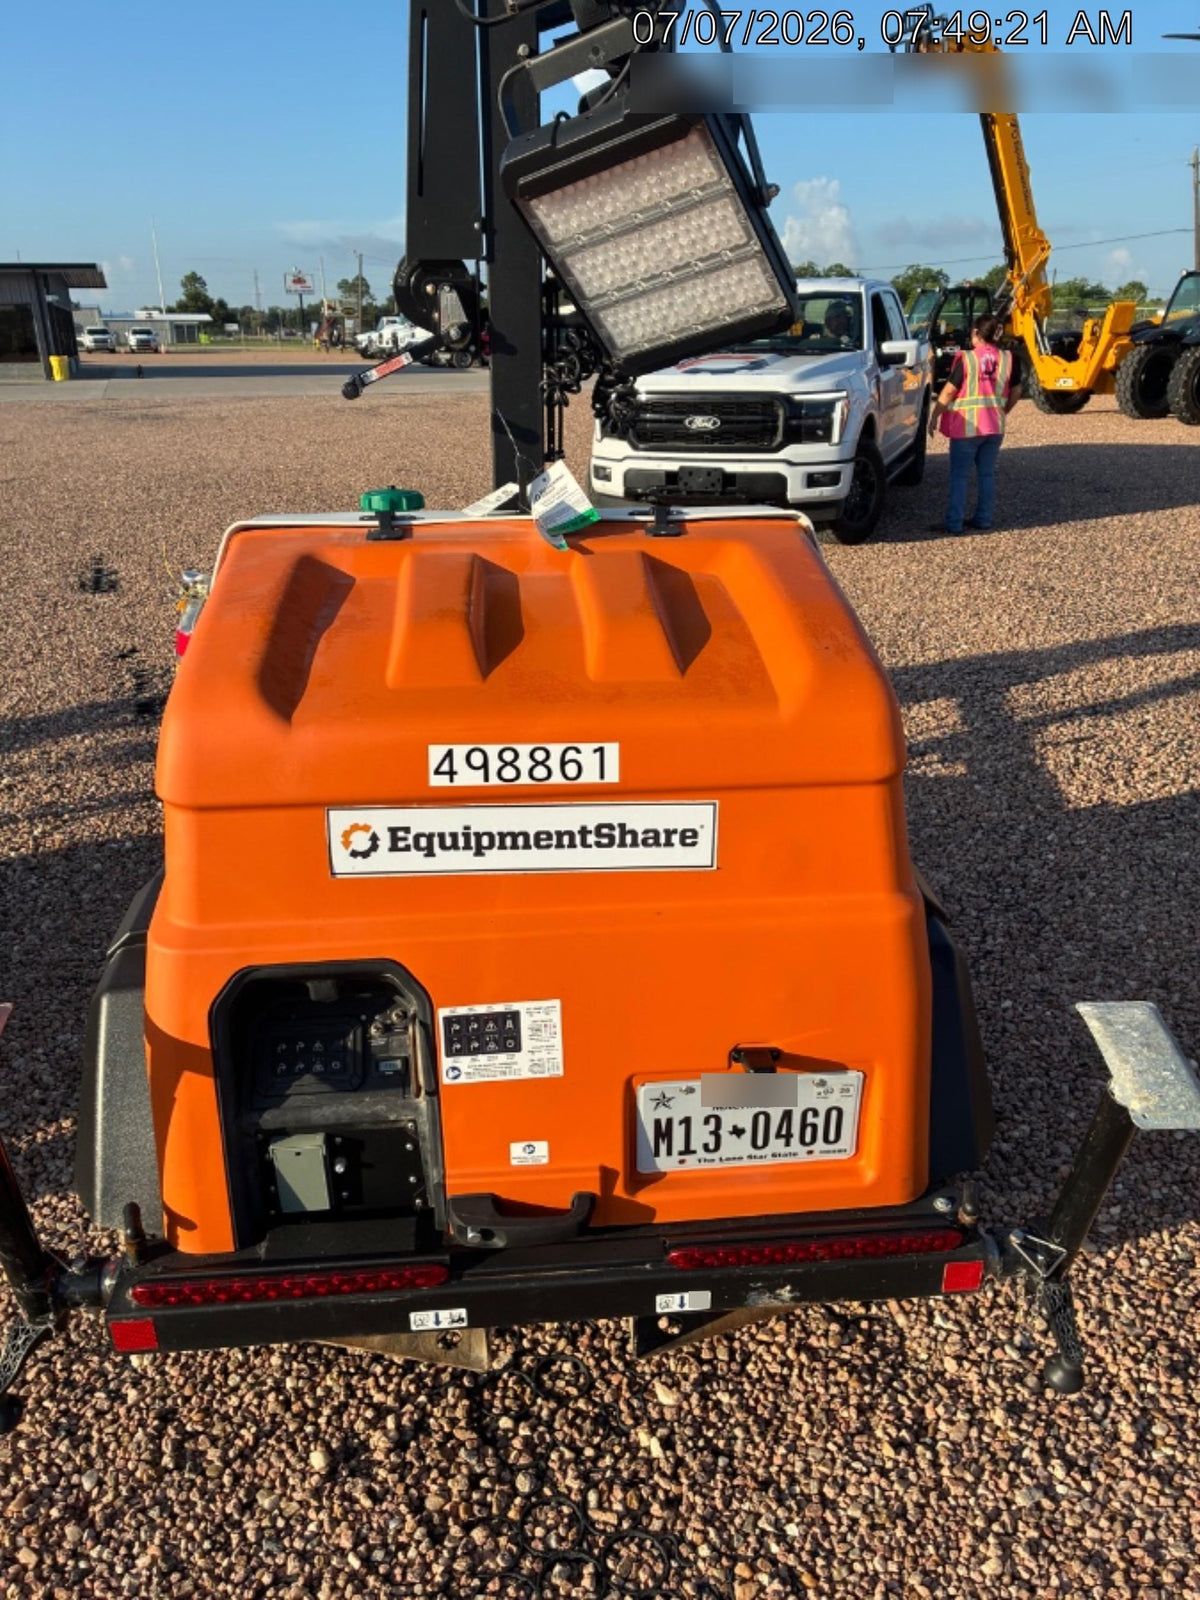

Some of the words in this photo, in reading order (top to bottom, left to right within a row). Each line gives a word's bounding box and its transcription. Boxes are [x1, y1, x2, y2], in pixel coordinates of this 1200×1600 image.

[433, 745, 606, 783] 498861
[387, 822, 700, 858] EquipmentShare
[653, 1113, 722, 1157] M13
[750, 1106, 844, 1151] 0460
[719, 1154, 744, 1163] Lone
[747, 1151, 768, 1160] Star
[771, 1150, 799, 1158] State
